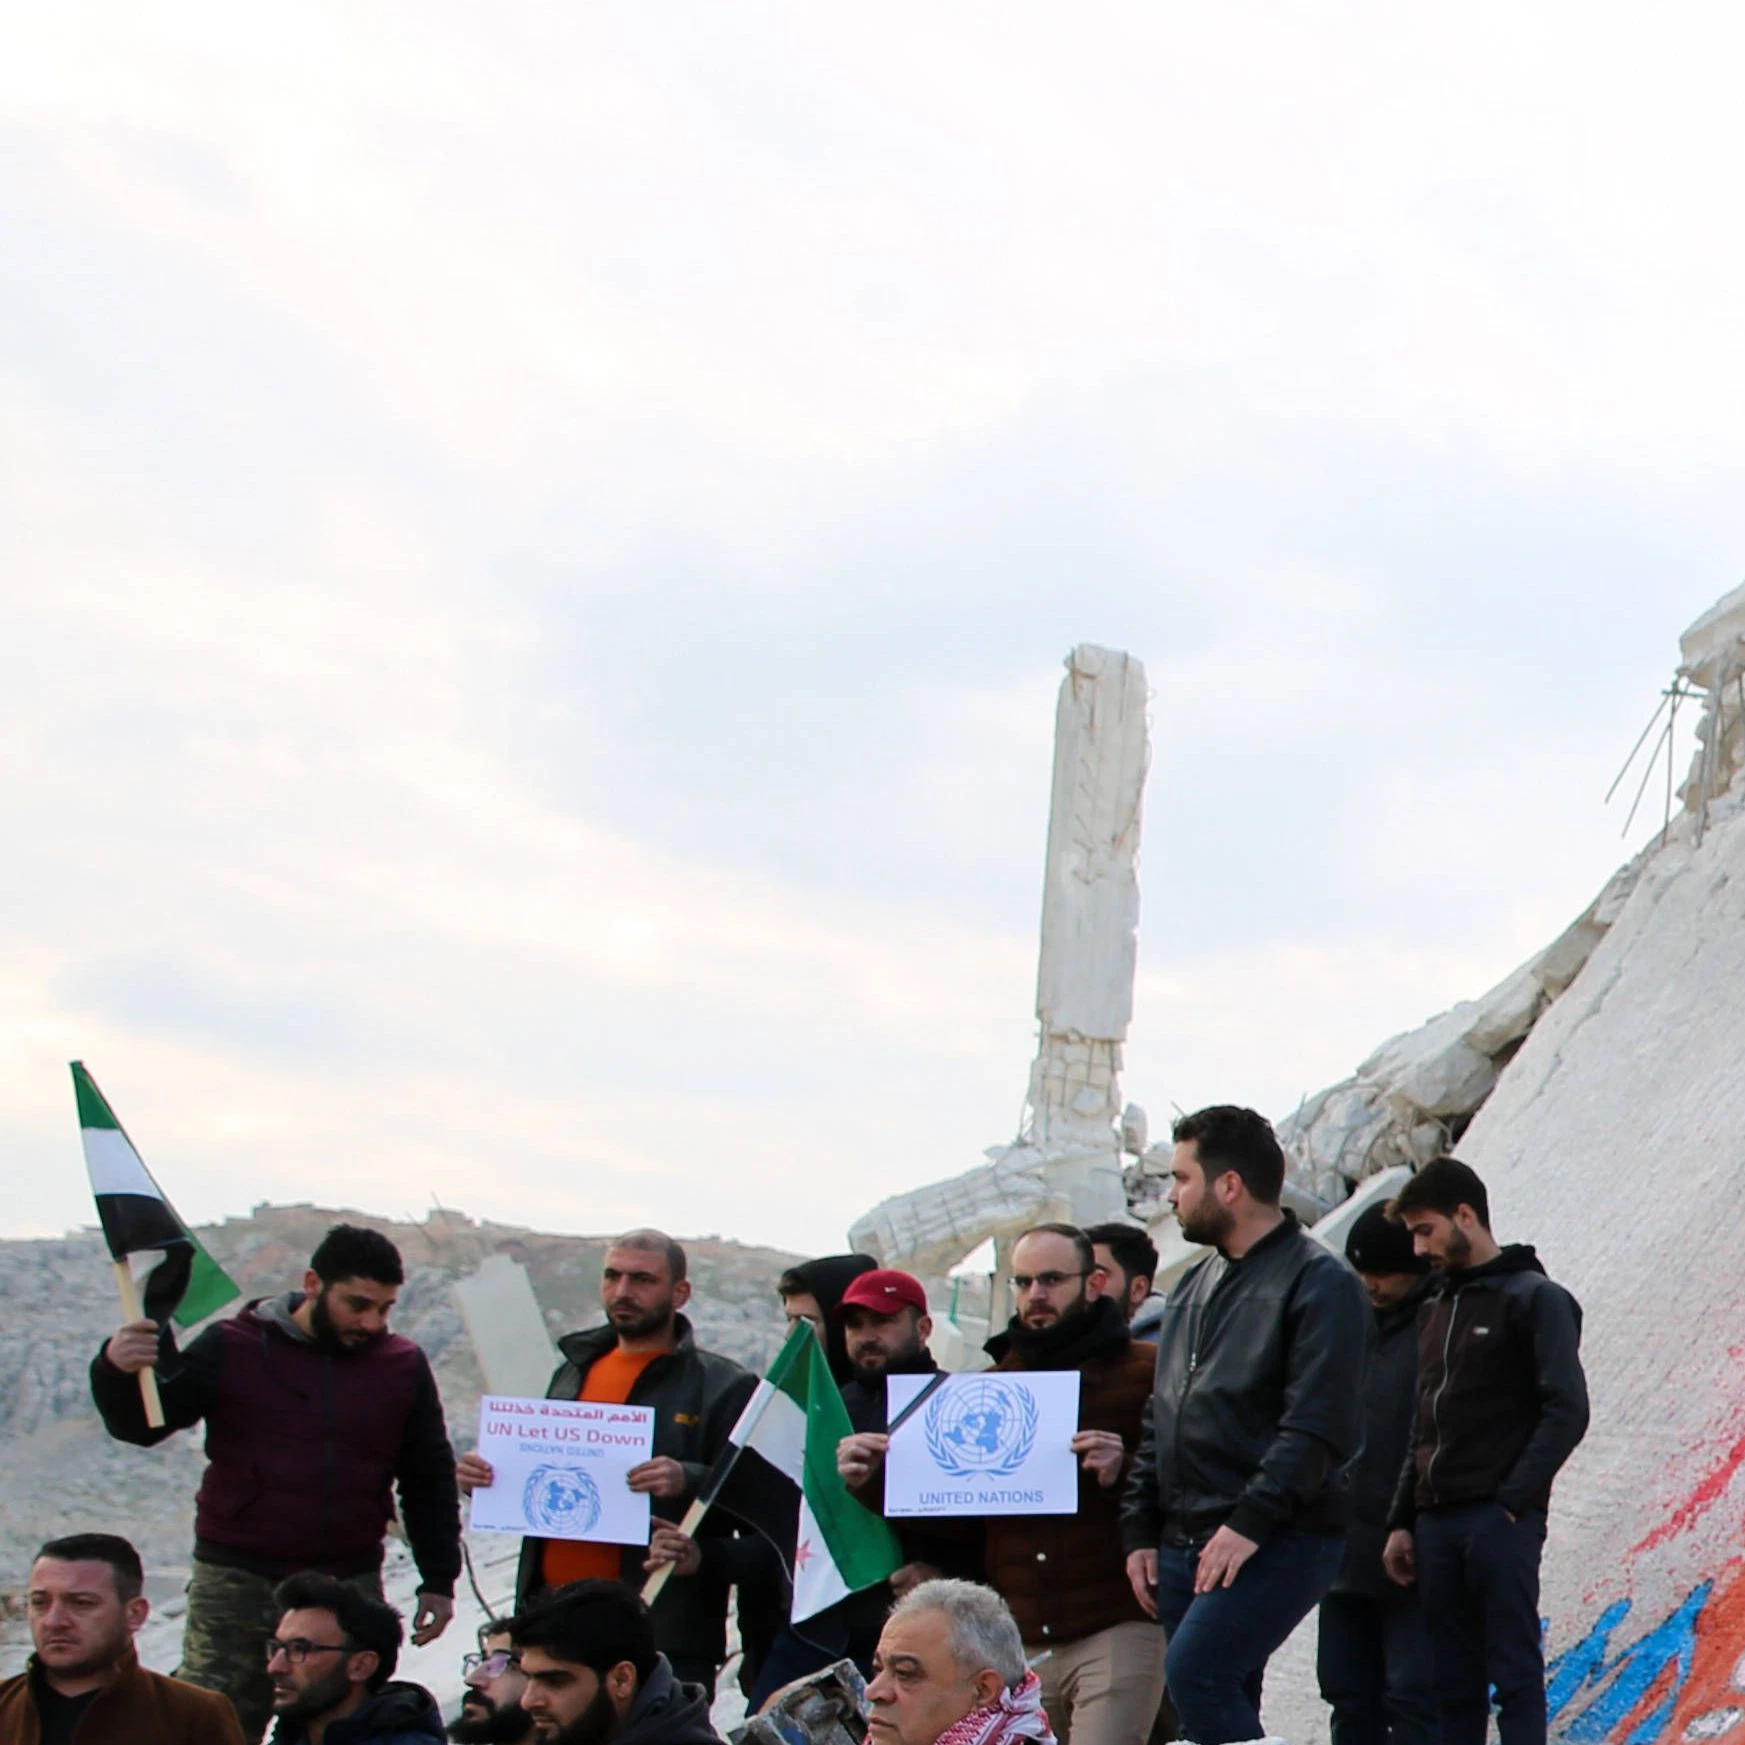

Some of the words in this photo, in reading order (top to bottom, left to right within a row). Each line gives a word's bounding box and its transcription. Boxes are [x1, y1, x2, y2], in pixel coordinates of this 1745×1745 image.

[487, 1421, 512, 1437] UN
[518, 1424, 549, 1440] Let
[554, 1426, 581, 1442] US
[586, 1429, 646, 1448] Down
[919, 1491, 975, 1505] UNITED
[978, 1490, 1045, 1504] NATIONS
